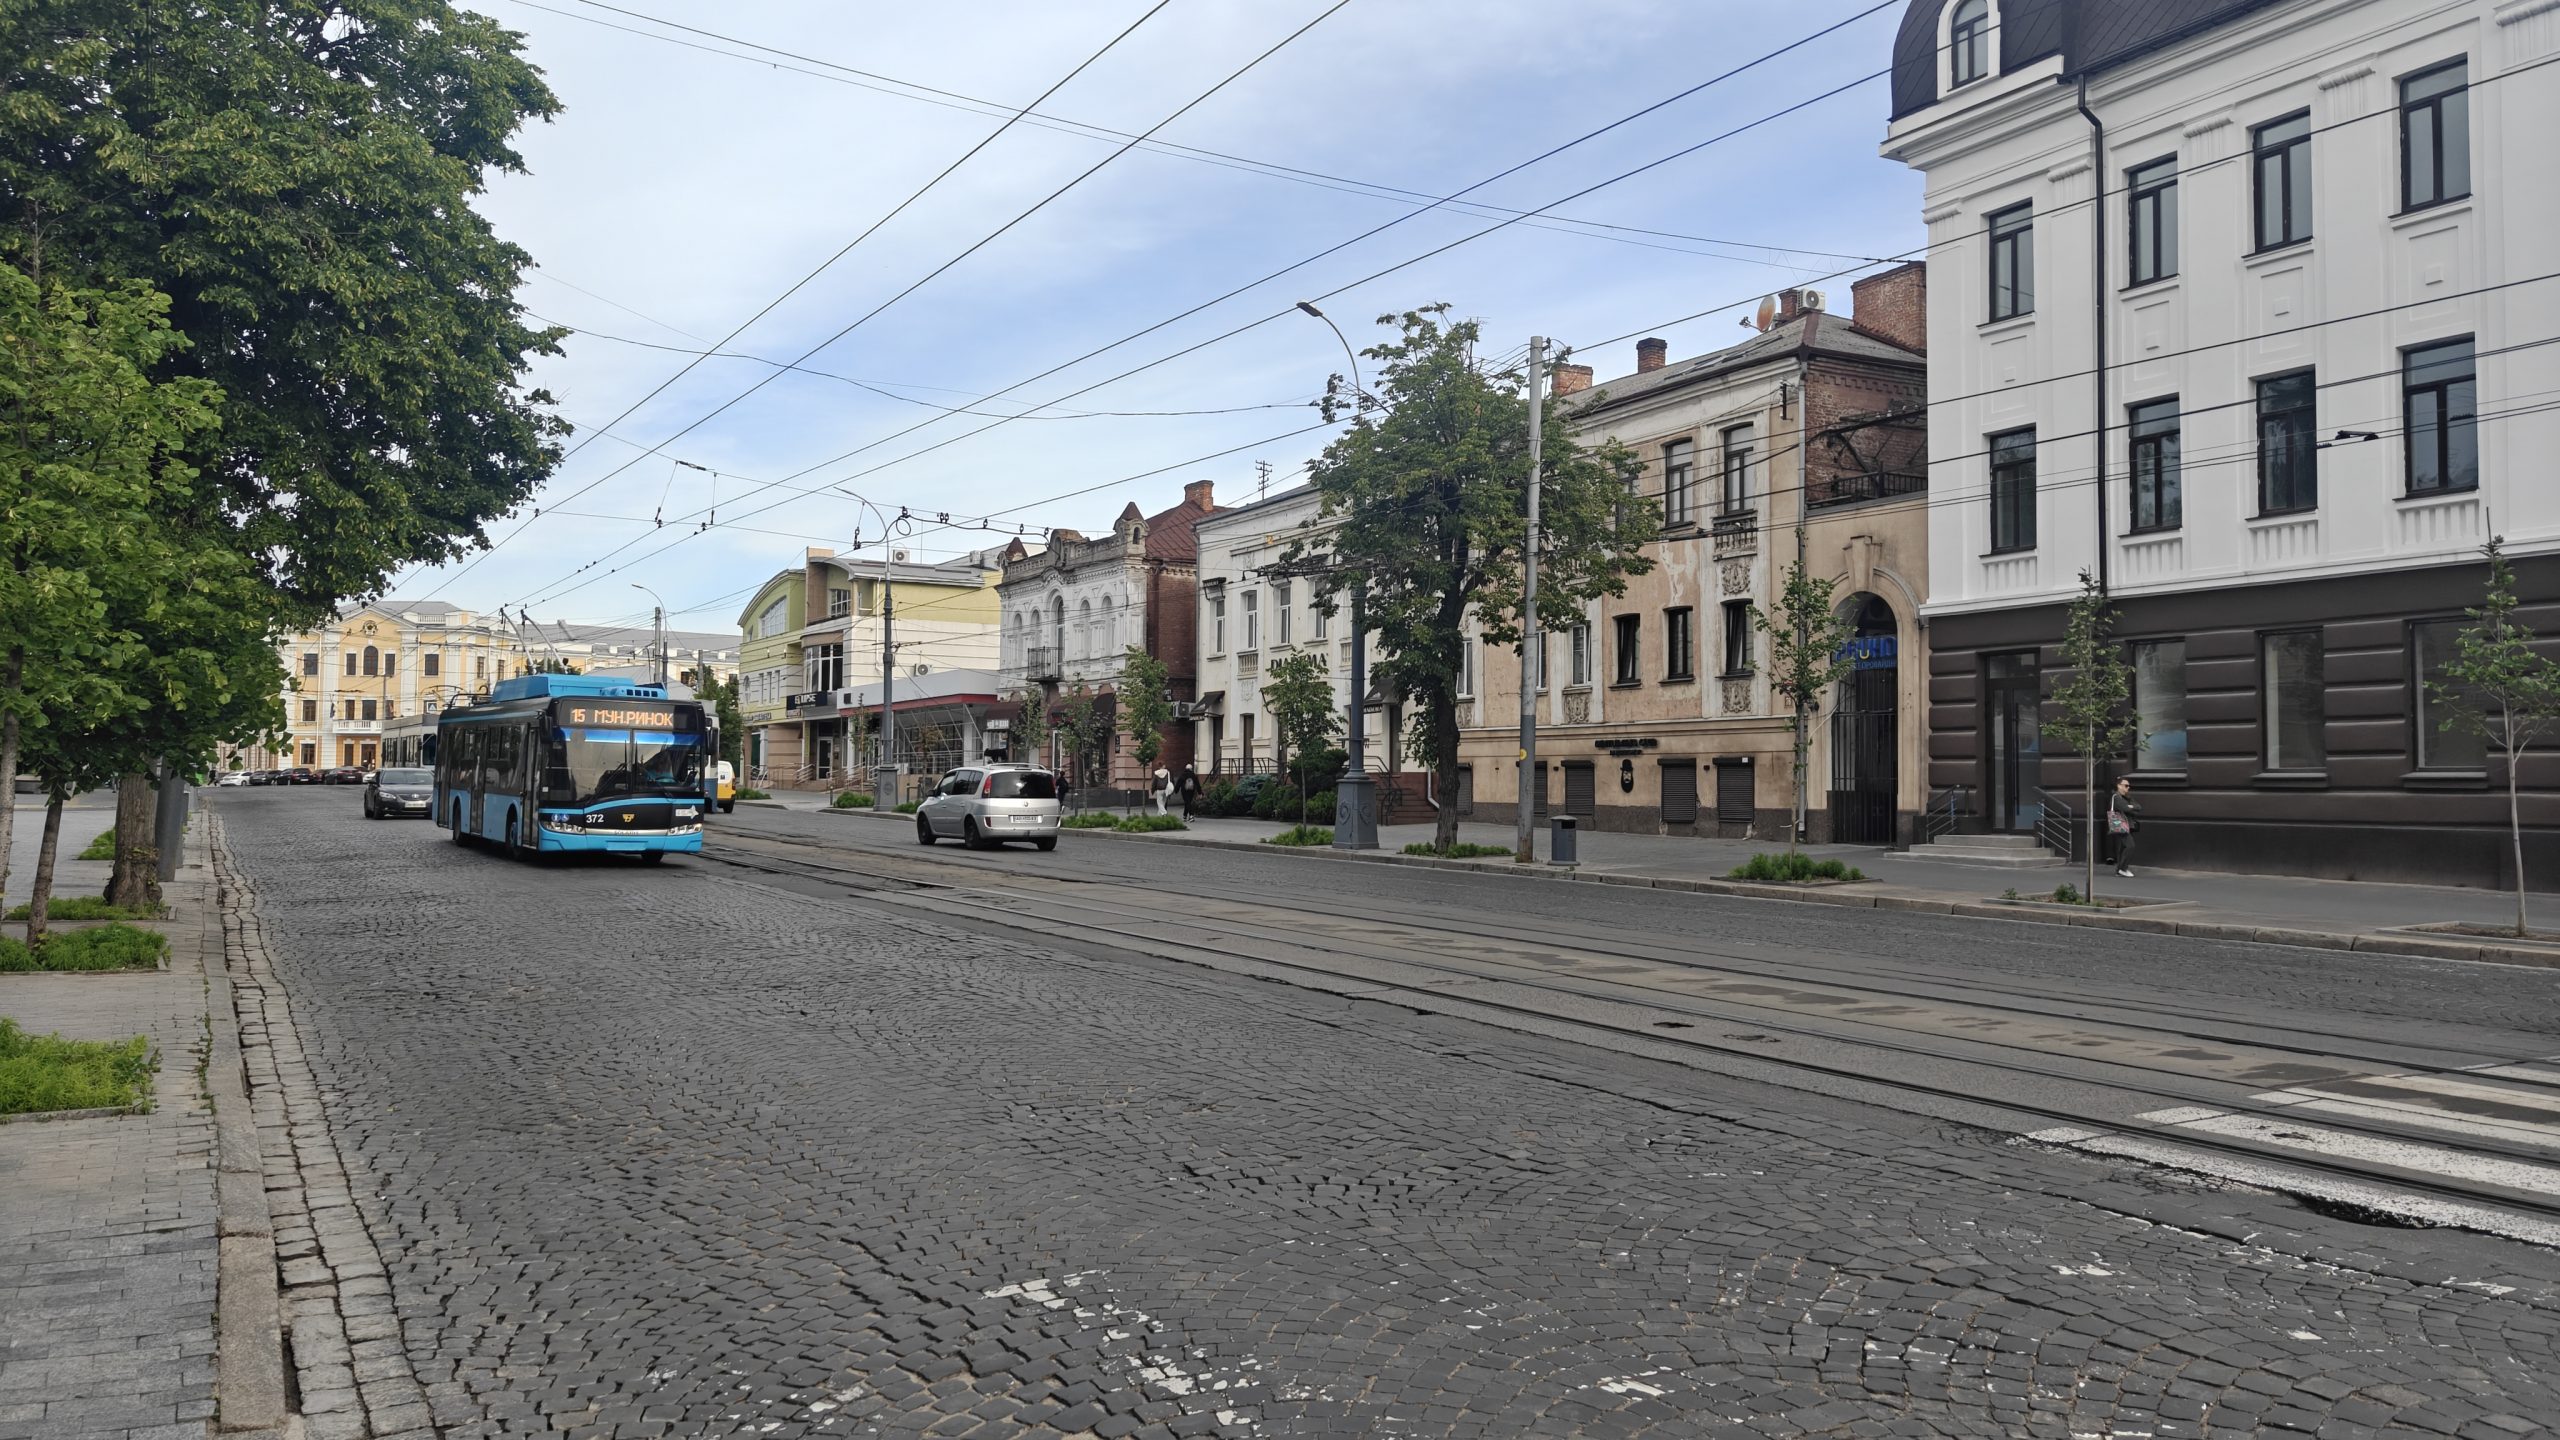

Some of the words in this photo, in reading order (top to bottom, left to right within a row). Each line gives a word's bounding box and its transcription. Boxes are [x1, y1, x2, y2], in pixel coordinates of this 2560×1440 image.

[1270, 653, 1327, 670] DIAMA
[571, 708, 586, 722] 15
[594, 709, 674, 726] МУН.РИНОК
[585, 814, 604, 823] 372
